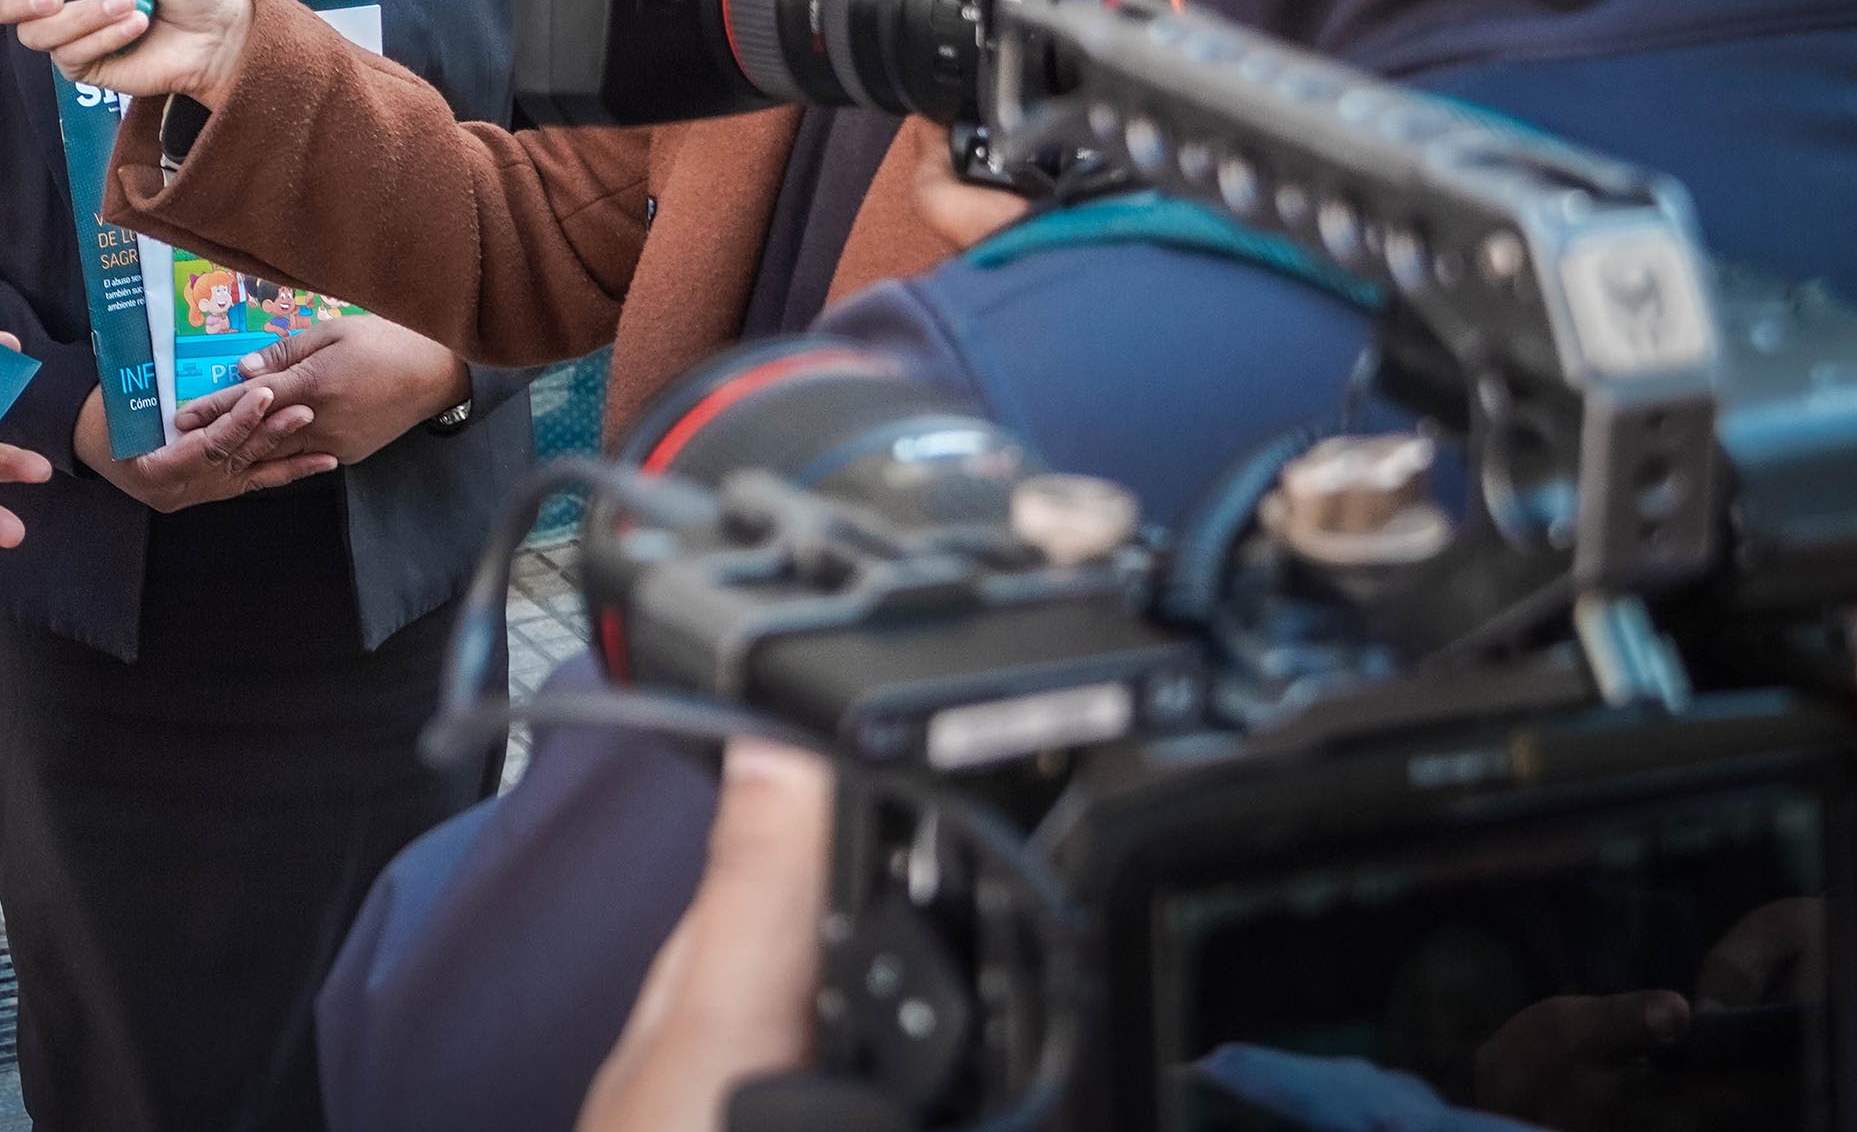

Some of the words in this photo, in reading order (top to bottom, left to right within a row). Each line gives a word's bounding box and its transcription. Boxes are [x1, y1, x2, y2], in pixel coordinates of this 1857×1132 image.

[98, 230, 118, 249] DE
[100, 248, 139, 270] SAGR
[111, 276, 131, 288] abuso
[105, 289, 132, 301] también
[107, 299, 137, 312] ambiente
[129, 395, 158, 412] Cómo
